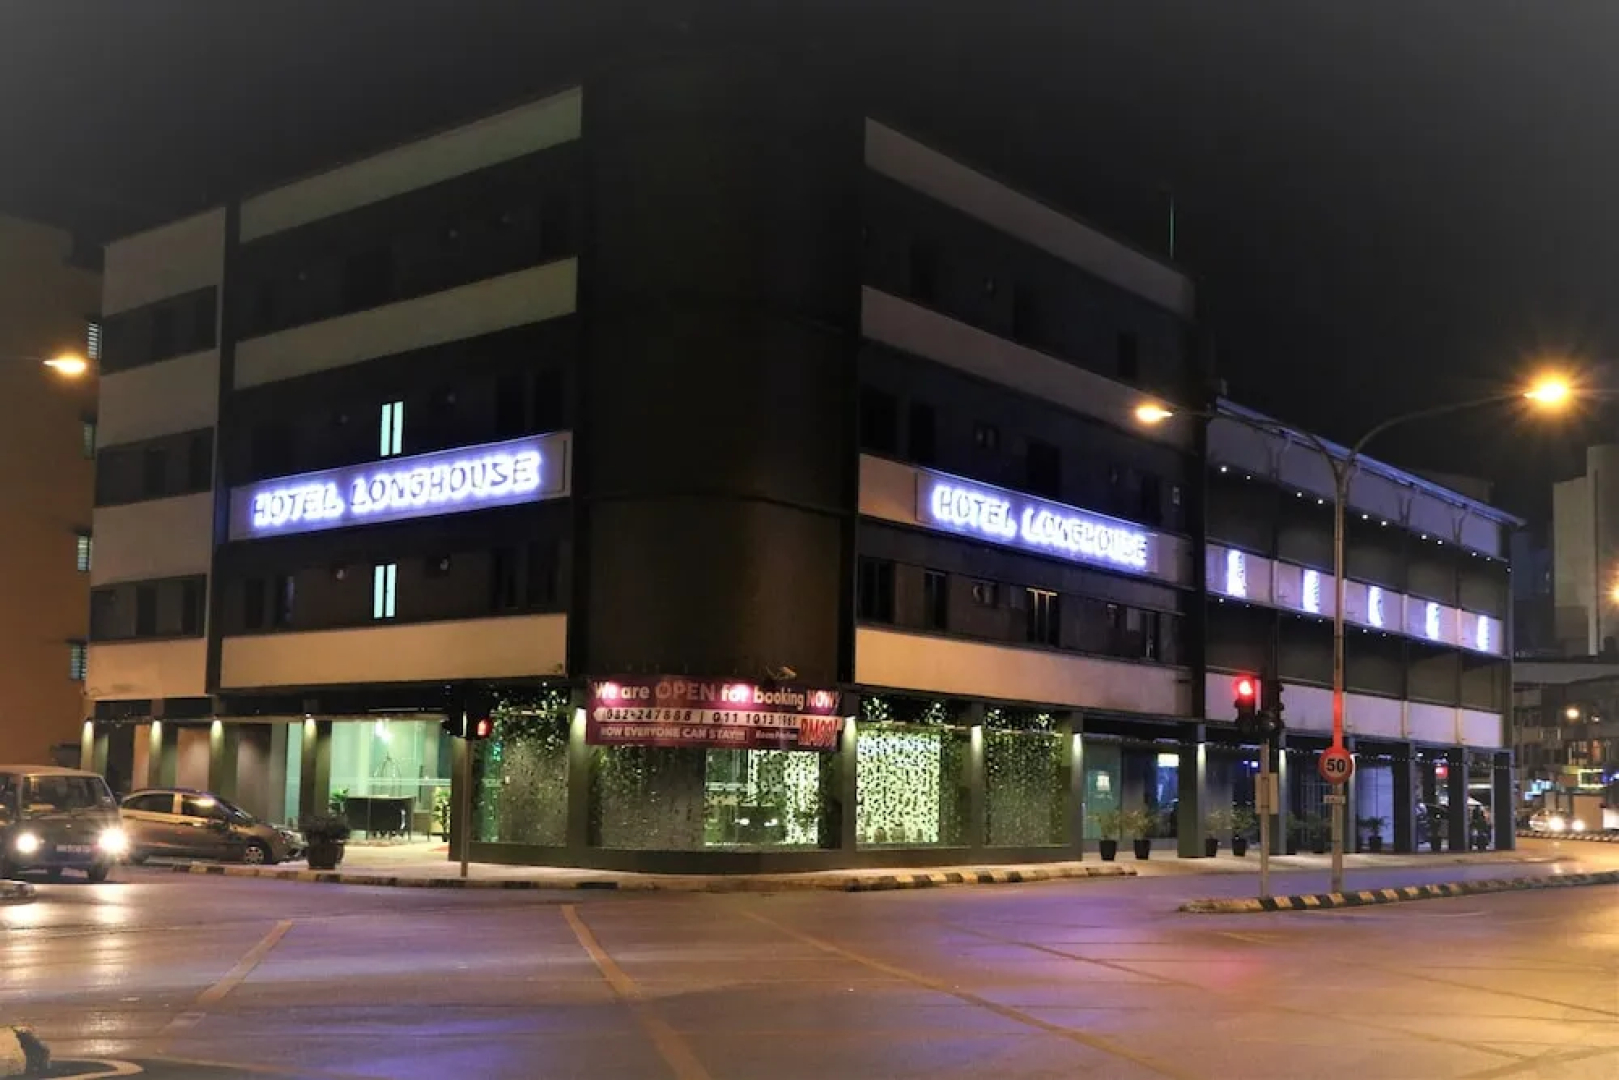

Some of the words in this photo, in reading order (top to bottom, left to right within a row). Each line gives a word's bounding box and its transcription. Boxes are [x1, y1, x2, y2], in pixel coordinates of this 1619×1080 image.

[252, 482, 343, 527] HOTEL
[349, 450, 541, 513] LONGHOUSE
[932, 486, 1016, 538] HOTEL
[1022, 507, 1147, 567] LONGHOUSE
[594, 681, 618, 699] We
[621, 686, 650, 699] are
[655, 680, 716, 700] OPEN
[721, 684, 750, 702] for
[754, 685, 804, 711] booking
[1326, 758, 1346, 773] 50
